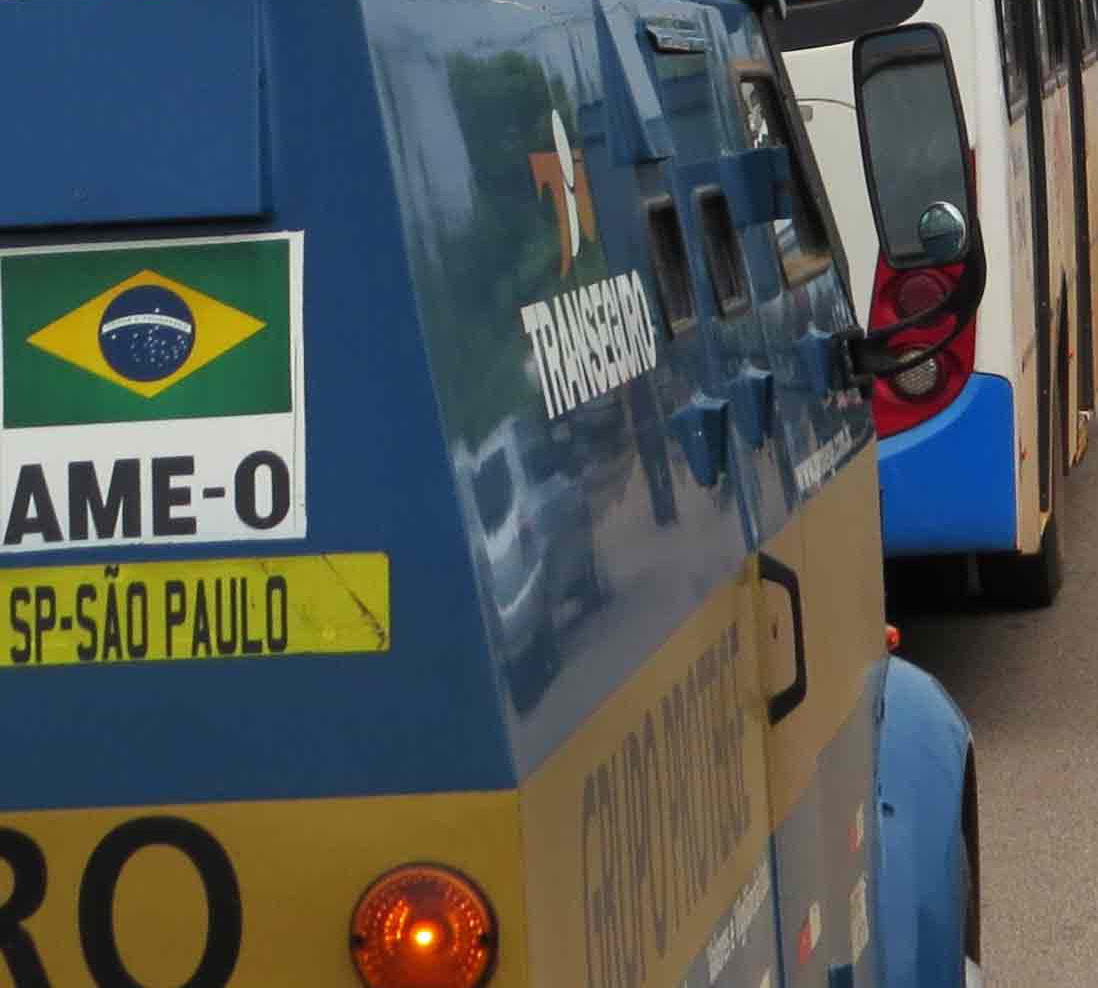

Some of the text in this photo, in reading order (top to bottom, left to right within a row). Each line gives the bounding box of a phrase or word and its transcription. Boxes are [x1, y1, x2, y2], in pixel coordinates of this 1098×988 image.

[519, 268, 657, 420] TRANSEGURO
[2, 449, 291, 546] AME-O
[9, 564, 289, 663] SP-SÃO PAULO
